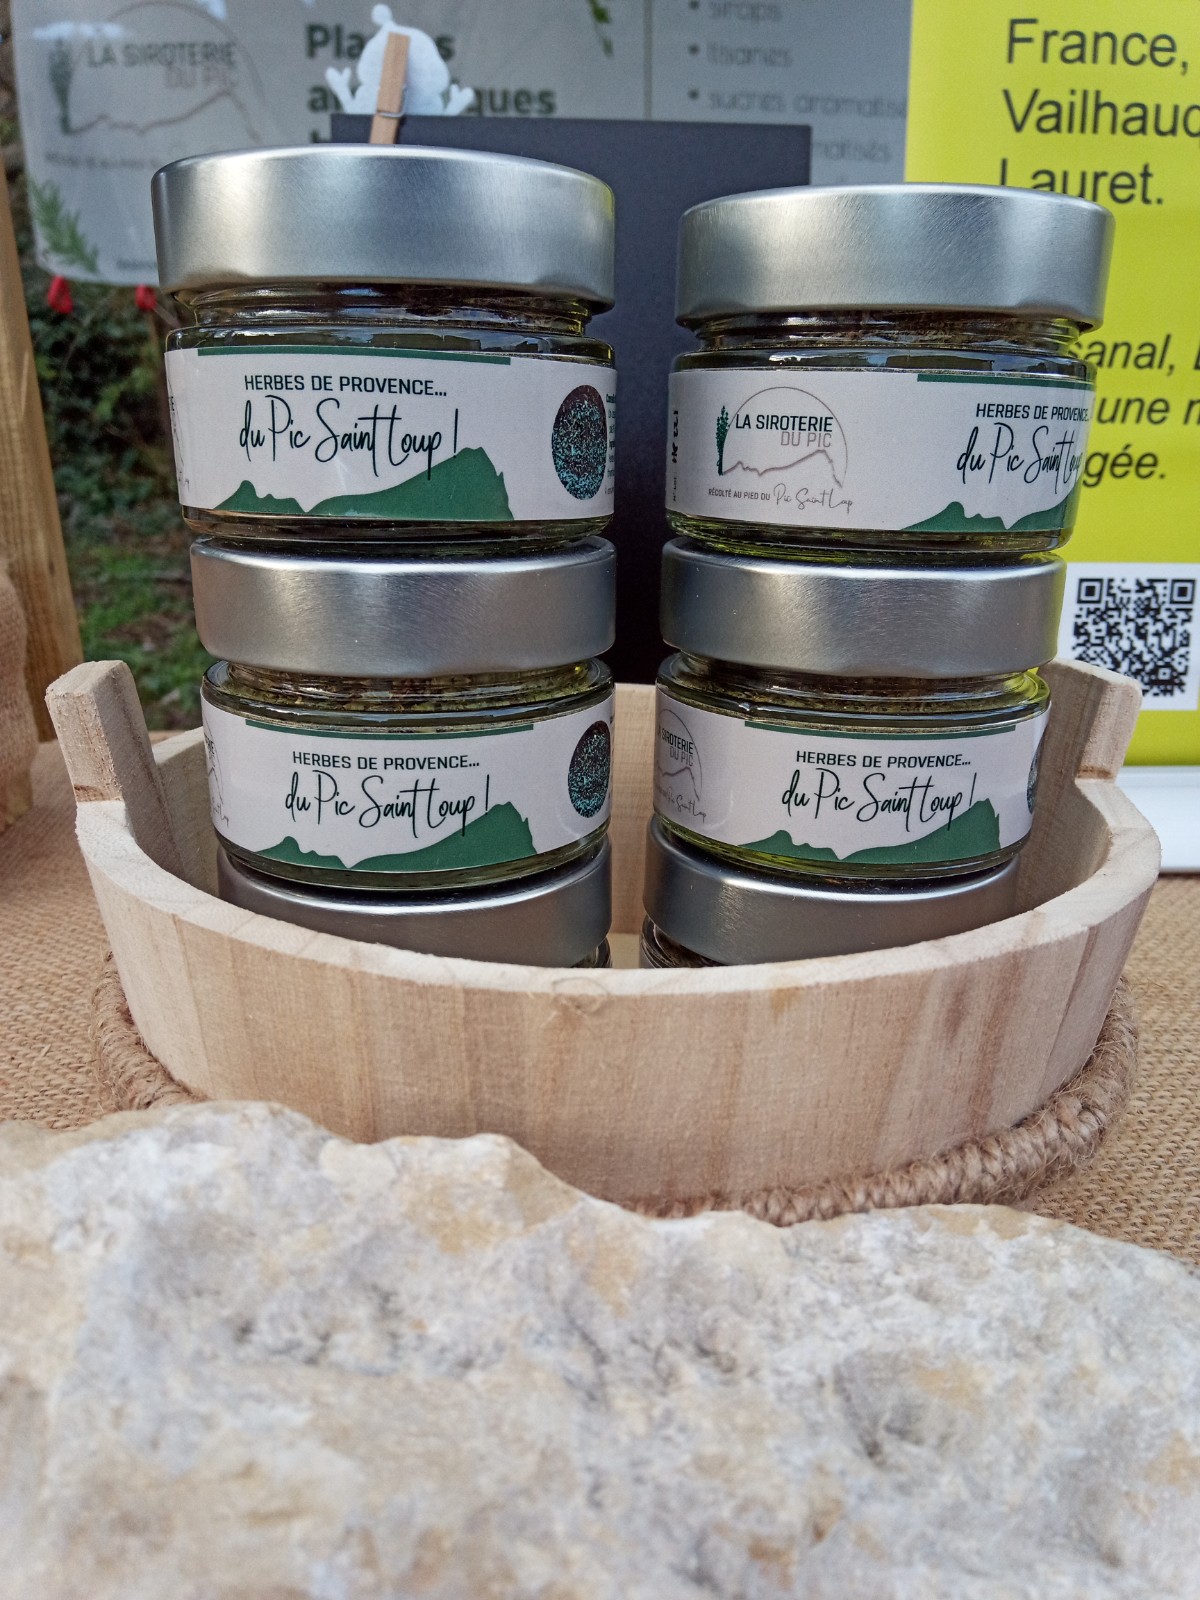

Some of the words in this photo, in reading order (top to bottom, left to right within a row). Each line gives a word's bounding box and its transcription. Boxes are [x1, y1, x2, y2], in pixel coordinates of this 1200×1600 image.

[1007, 18, 1189, 76] France,
[244, 375, 304, 391] HERBES
[311, 376, 333, 391] DE
[340, 376, 447, 397] PROVENCE...
[976, 403, 1030, 419] HERBES
[1034, 405, 1048, 419] DE
[1097, 398, 1170, 425] une
[735, 414, 751, 429] LA
[756, 415, 834, 433] SIROTERIE
[239, 400, 265, 462] du
[264, 395, 311, 462] Pic
[315, 398, 395, 477] Saint
[781, 432, 801, 447] DU
[807, 432, 832, 448] PIC
[957, 426, 986, 484] du
[990, 422, 1024, 484] Pic
[708, 488, 732, 498] RÉCOLTÉ
[733, 490, 742, 499] AU
[744, 491, 759, 500] PIED
[760, 492, 771, 501] DU
[292, 751, 351, 769] HERBES
[357, 757, 378, 770] DE
[384, 755, 480, 770] PROVENCE...
[796, 750, 857, 767] HERBES
[862, 755, 883, 768] DE
[887, 754, 971, 768] PROVENCE...
[285, 771, 311, 822] du
[312, 770, 355, 825] Pic
[359, 775, 431, 838] Saint
[781, 769, 810, 817] du
[814, 767, 855, 819] Pic
[856, 773, 920, 832] Saint
